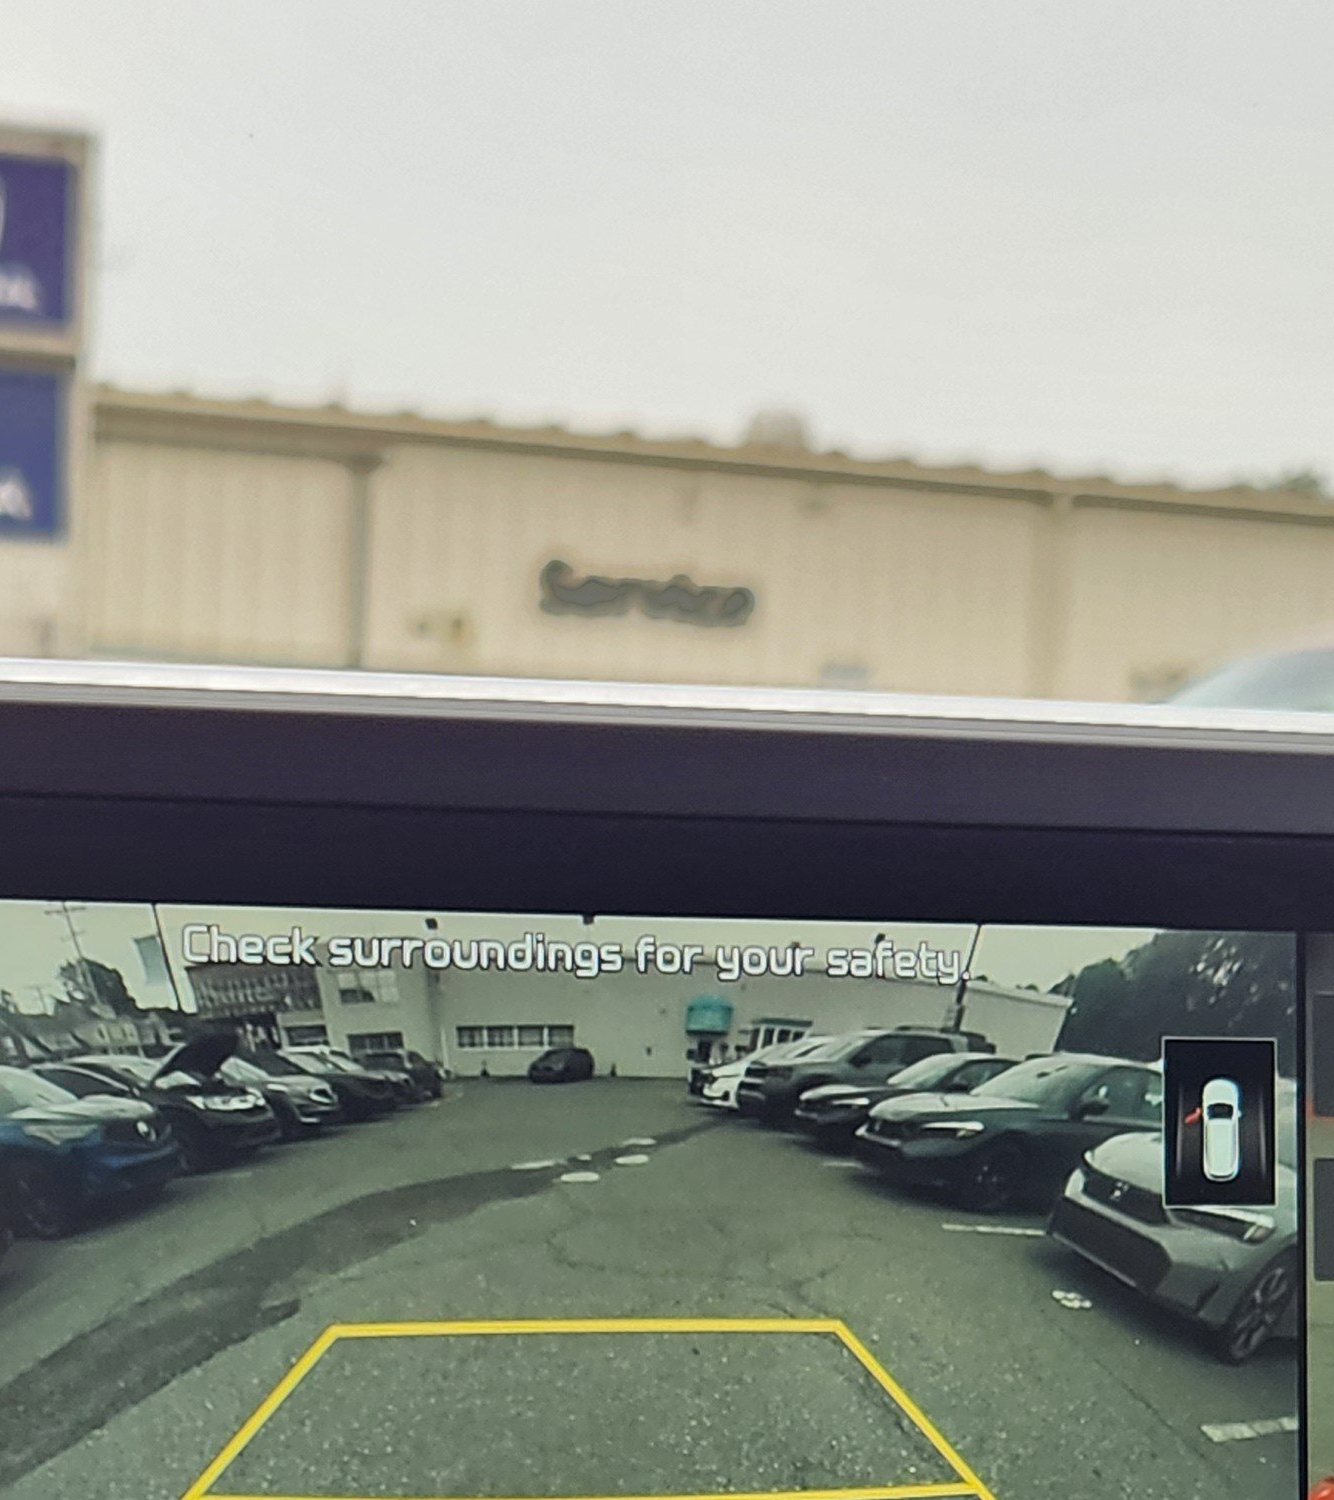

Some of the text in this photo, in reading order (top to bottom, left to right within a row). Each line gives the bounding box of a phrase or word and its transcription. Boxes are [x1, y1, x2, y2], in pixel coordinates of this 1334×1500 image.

[181, 923, 321, 967] Check
[327, 930, 625, 979] surroundings
[634, 935, 704, 975] for
[716, 943, 816, 982] your
